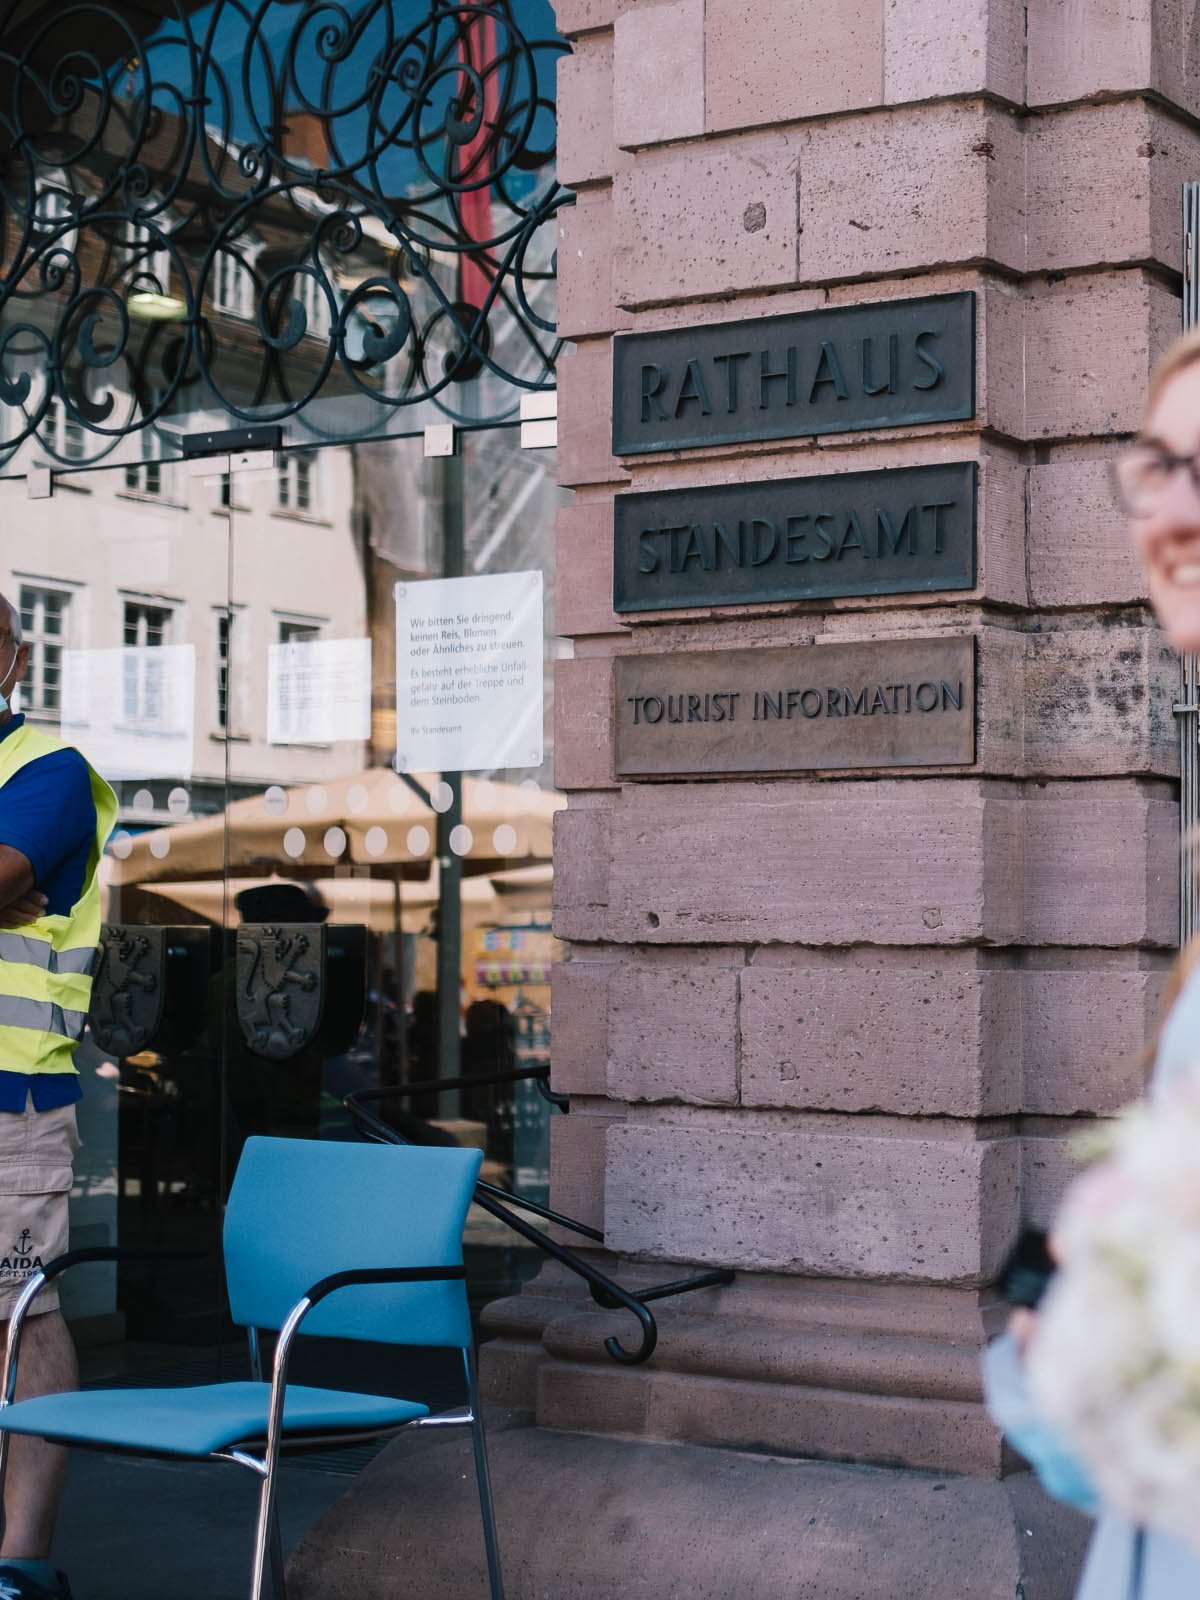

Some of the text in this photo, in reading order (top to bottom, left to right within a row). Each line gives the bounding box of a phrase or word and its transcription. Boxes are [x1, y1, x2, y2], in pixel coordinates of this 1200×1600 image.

[640, 331, 943, 422] RATHAUS
[639, 501, 955, 574] STANDESAMT
[410, 618, 425, 629] Wir
[427, 616, 454, 627] bitten
[456, 615, 469, 626] Sie
[410, 628, 497, 642] keinen Reis, Blumen
[410, 646, 430, 657] oder
[476, 643, 487, 652] zu
[410, 669, 419, 679] Es
[421, 666, 452, 678] besteht
[455, 663, 498, 676] erhebliche
[440, 680, 455, 690] auf
[457, 678, 471, 690] der
[475, 677, 504, 690] Treppe
[506, 676, 524, 687] und
[410, 695, 430, 706] dem
[627, 680, 964, 725] TOURIST INFORMATION
[422, 723, 462, 734] Standesamt
[0, 1255, 43, 1269] AIDA
